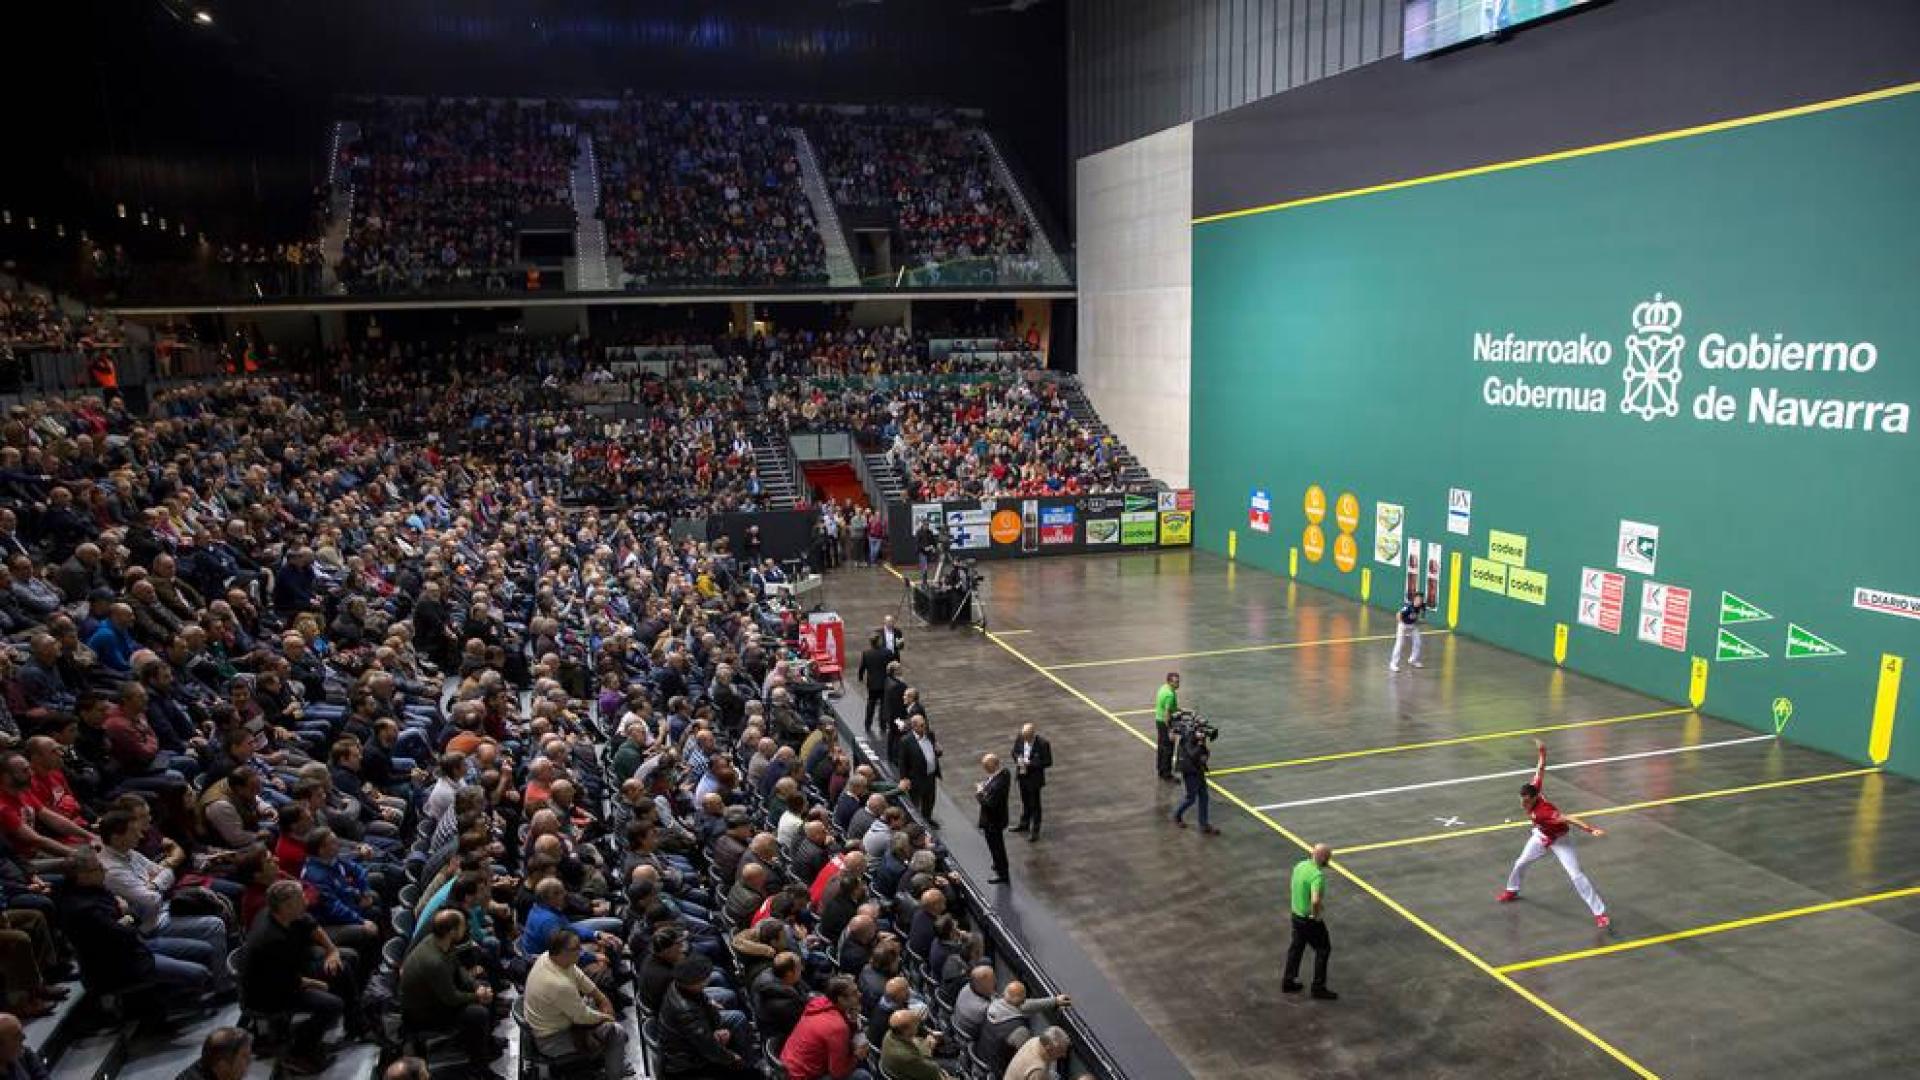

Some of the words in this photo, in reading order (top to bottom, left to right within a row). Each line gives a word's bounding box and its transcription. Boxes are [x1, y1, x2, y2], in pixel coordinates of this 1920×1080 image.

[1473, 332, 1613, 366] Nafarroako
[1698, 332, 1878, 373] Gobierno
[1482, 375, 1607, 413] Gobernua
[1692, 385, 1737, 422] de
[1747, 386, 1911, 434] Navarra
[1490, 540, 1523, 558] codere
[1472, 568, 1504, 586] codere
[1510, 577, 1543, 595] codere
[1871, 594, 1909, 609] DIARIO
[1886, 658, 1896, 673] 4
